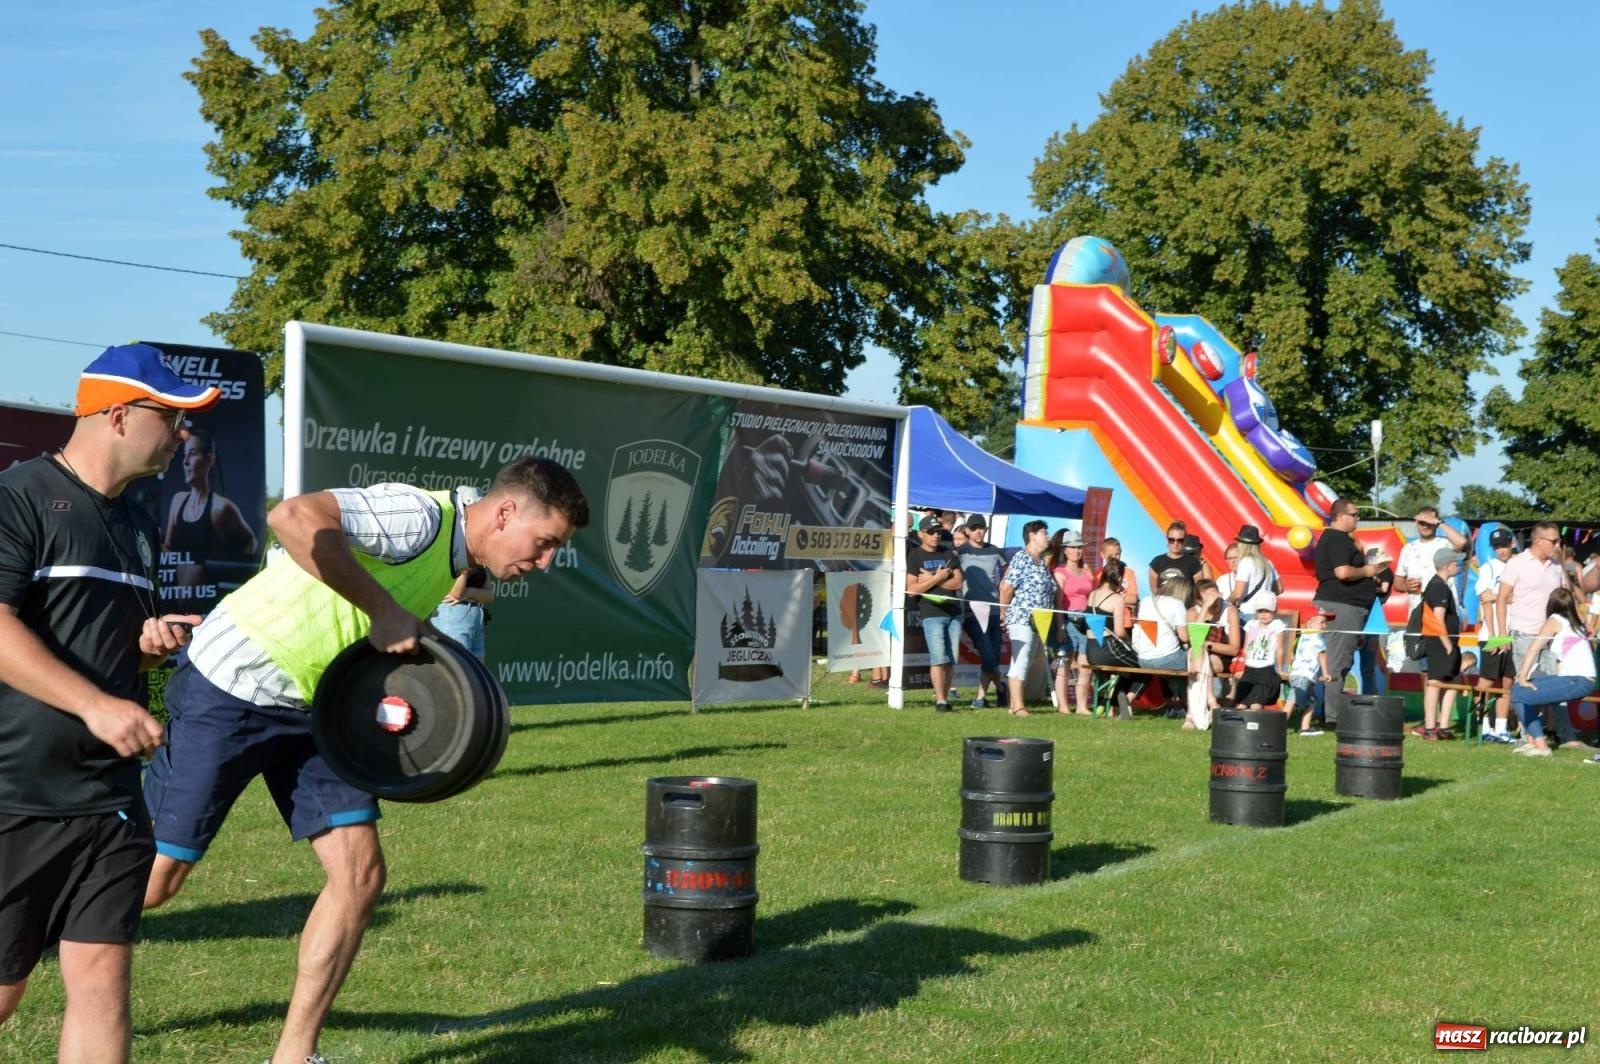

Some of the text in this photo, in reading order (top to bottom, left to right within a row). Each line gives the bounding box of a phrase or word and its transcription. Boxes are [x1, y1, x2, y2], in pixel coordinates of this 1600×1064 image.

[730, 412, 763, 429] STUDIO
[824, 423, 888, 441] POLEROWANIA
[303, 417, 397, 455] Drzewka
[402, 425, 413, 456] i
[414, 426, 496, 469] krzewy
[817, 440, 886, 459] SAMOCHODÓW
[730, 535, 781, 561] Detailing
[810, 531, 831, 549] 503
[852, 533, 882, 550] 845
[195, 585, 217, 598] US
[498, 652, 674, 688] www.jodelka.info
